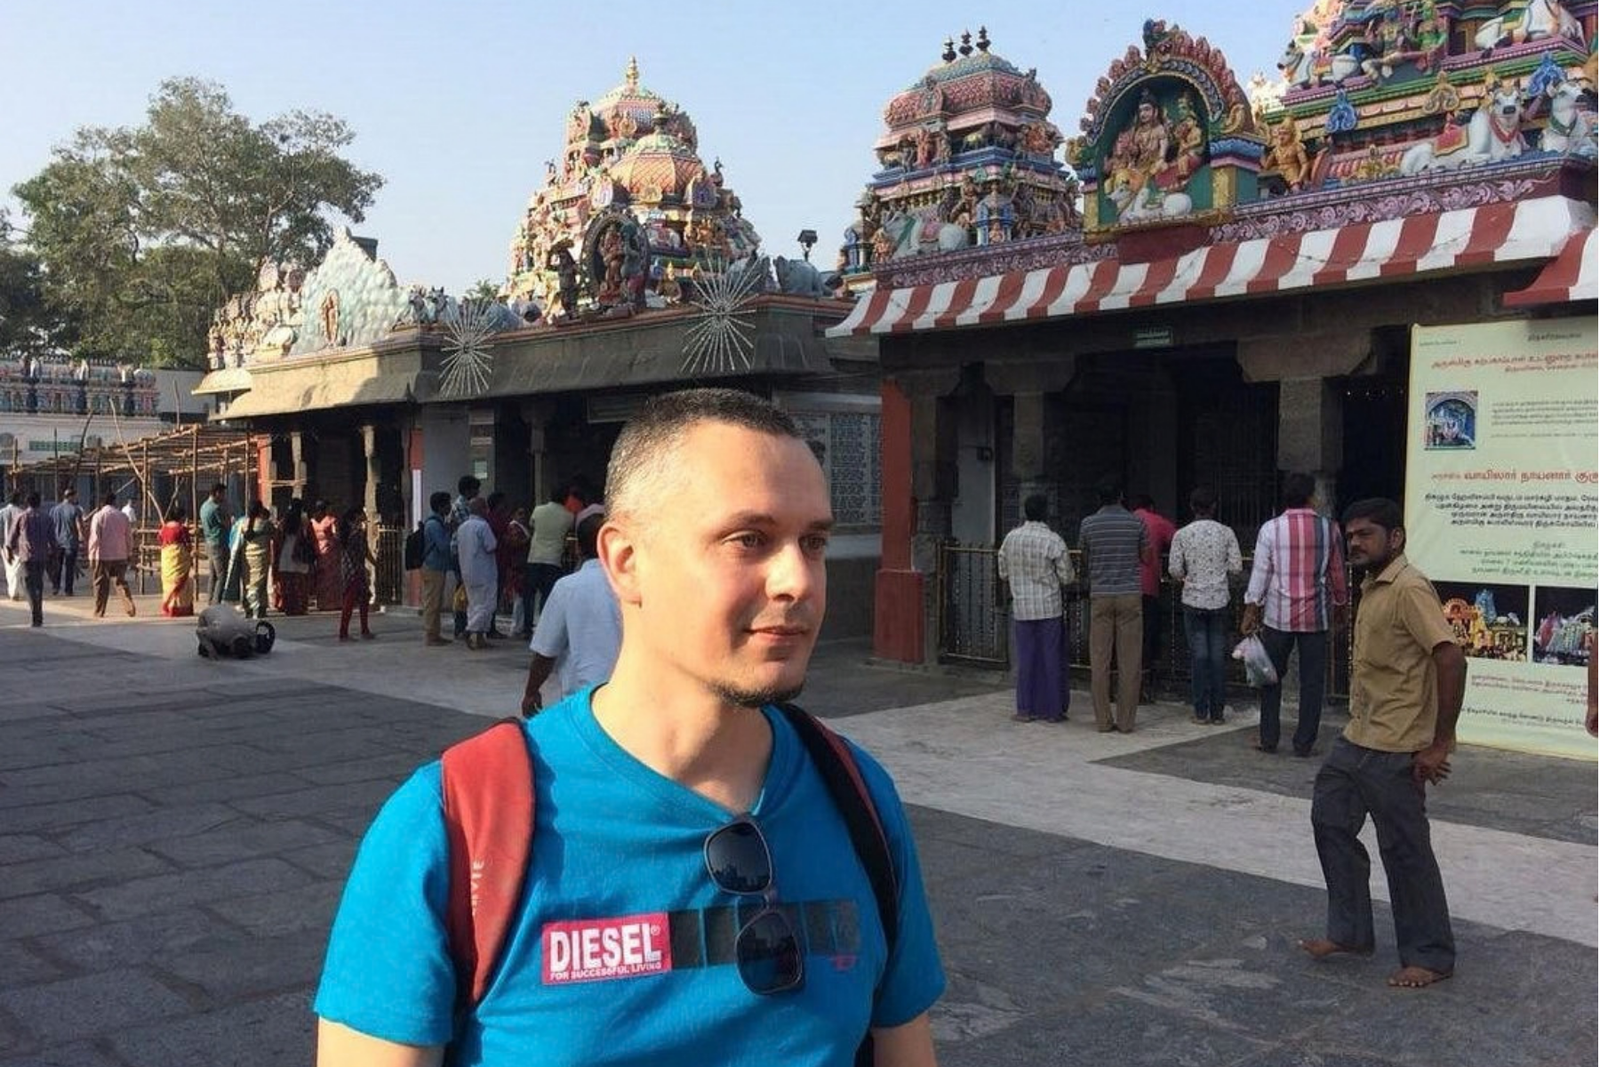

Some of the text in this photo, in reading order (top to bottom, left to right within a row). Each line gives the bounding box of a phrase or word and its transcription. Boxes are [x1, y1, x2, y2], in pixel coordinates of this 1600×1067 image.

[550, 962, 661, 981] FOR SUCCESSFUL LIVING
